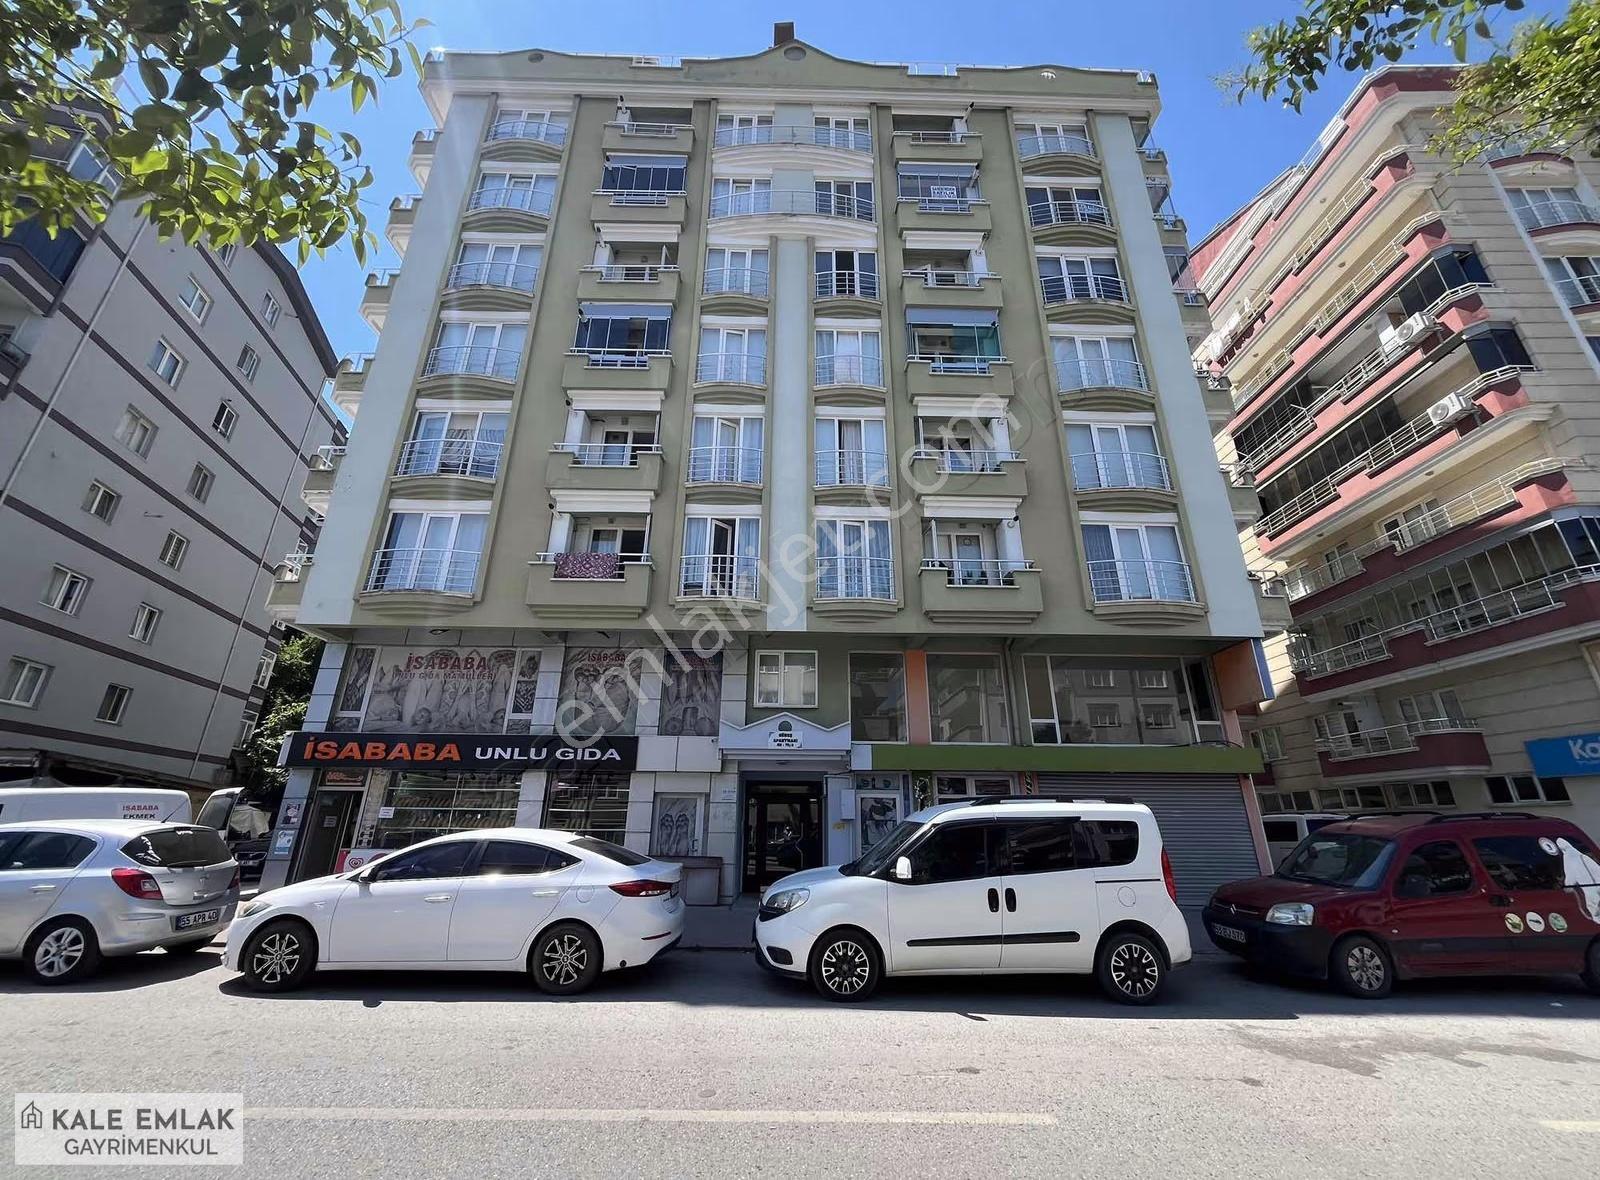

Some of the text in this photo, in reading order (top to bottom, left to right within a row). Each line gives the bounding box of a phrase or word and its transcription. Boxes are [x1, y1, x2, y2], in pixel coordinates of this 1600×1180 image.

[405, 652, 488, 670] İSABABA
[303, 736, 622, 762] İSABABA UNLU GIDA
[192, 912, 206, 924] APR
